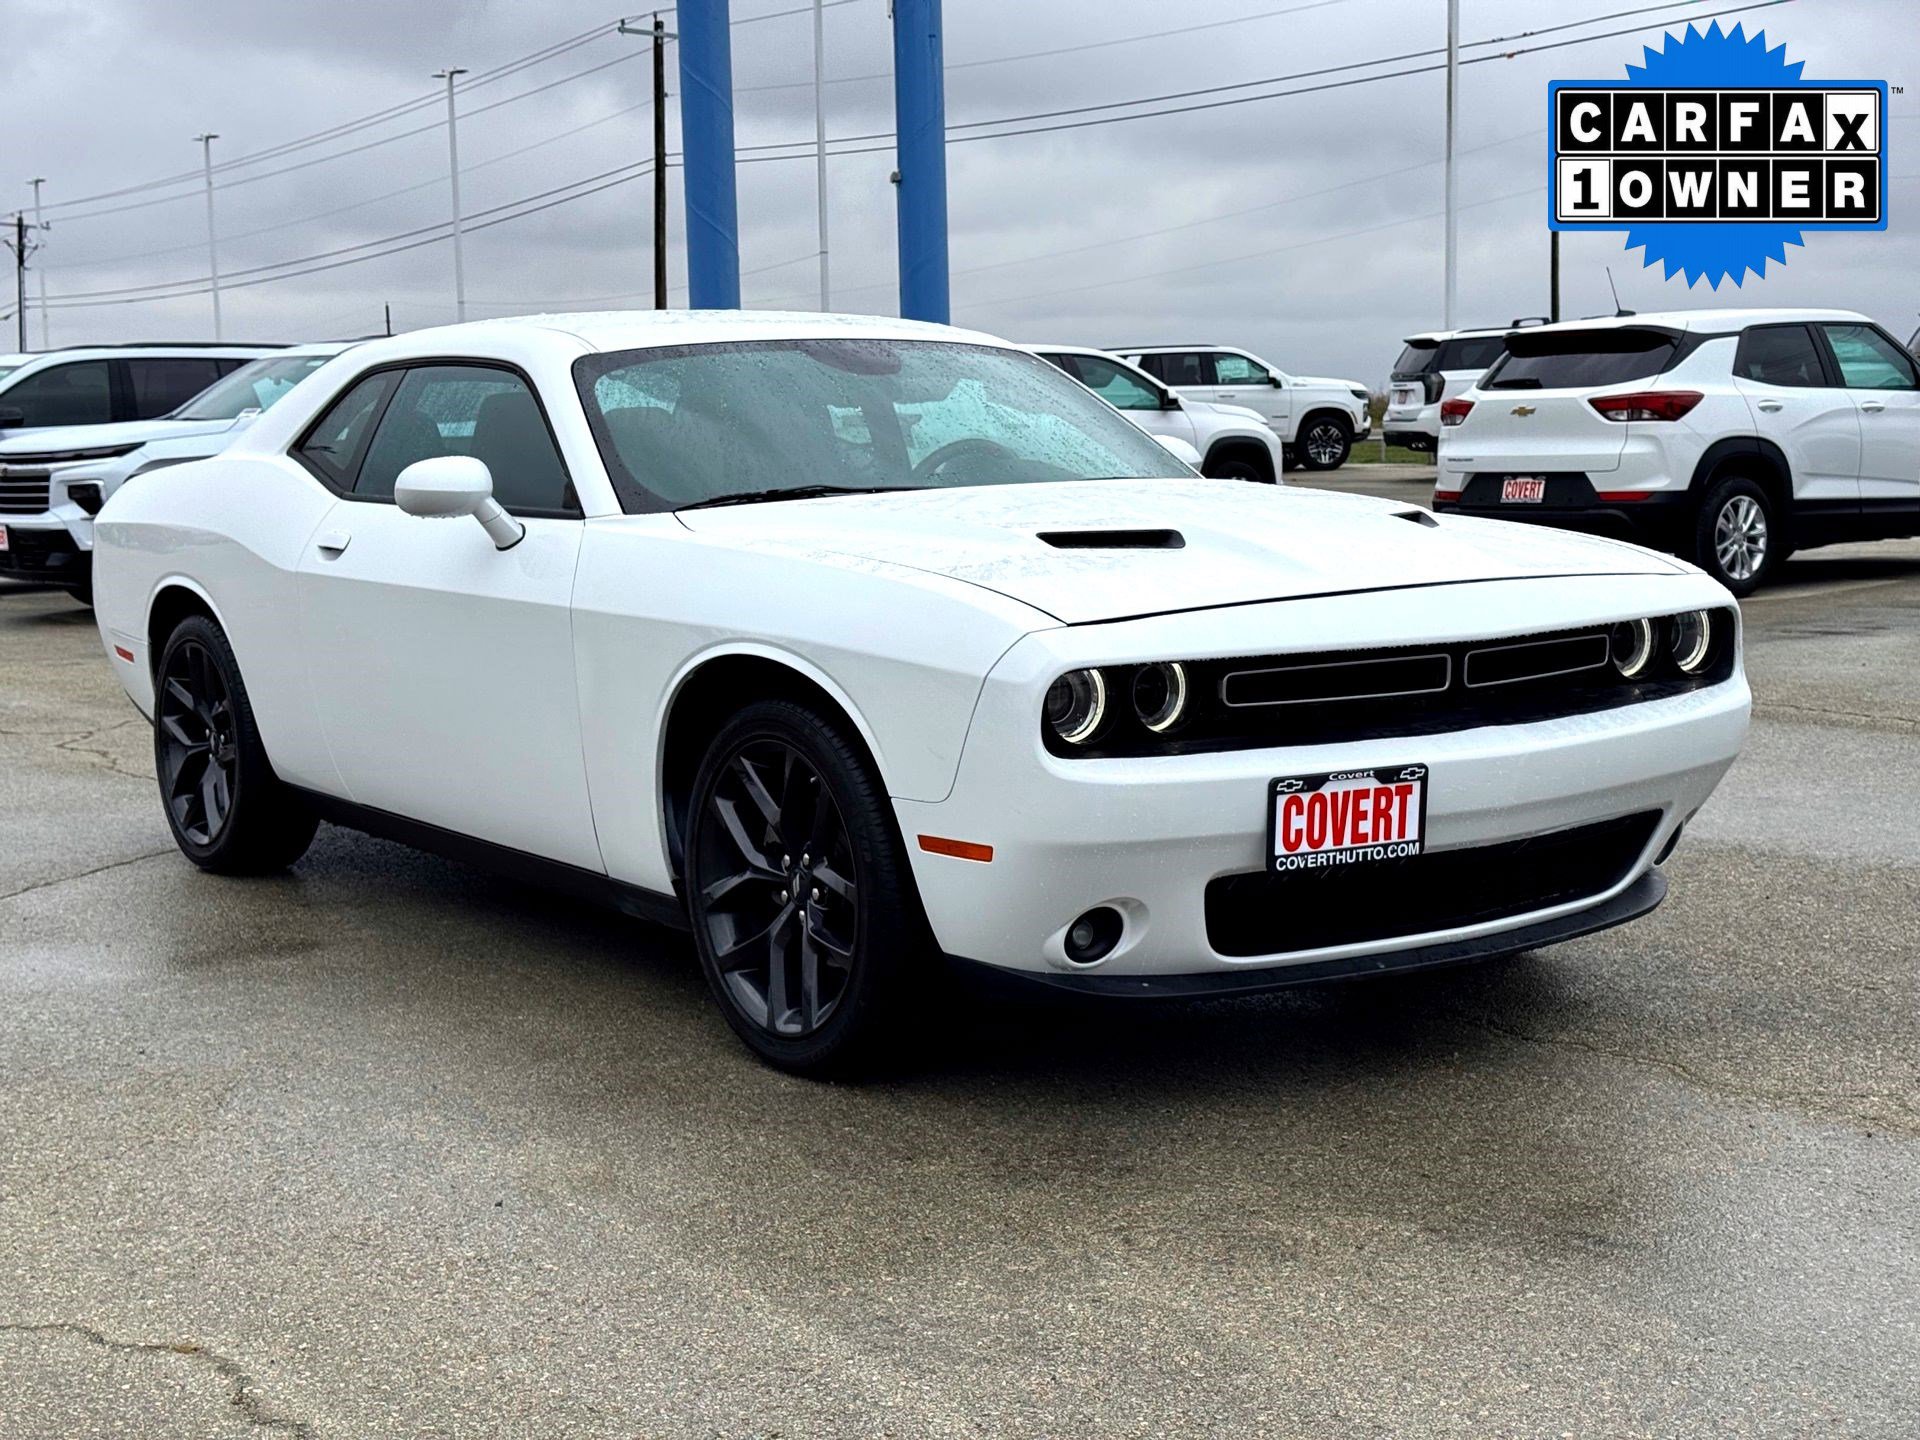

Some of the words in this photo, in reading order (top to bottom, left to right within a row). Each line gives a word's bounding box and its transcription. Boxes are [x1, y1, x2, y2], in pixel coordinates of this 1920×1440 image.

[1505, 481, 1542, 498] COVERT
[1328, 769, 1375, 781] Covert
[1282, 783, 1414, 853] COVERT
[1275, 842, 1420, 871] COVERTHUTTO.COM
